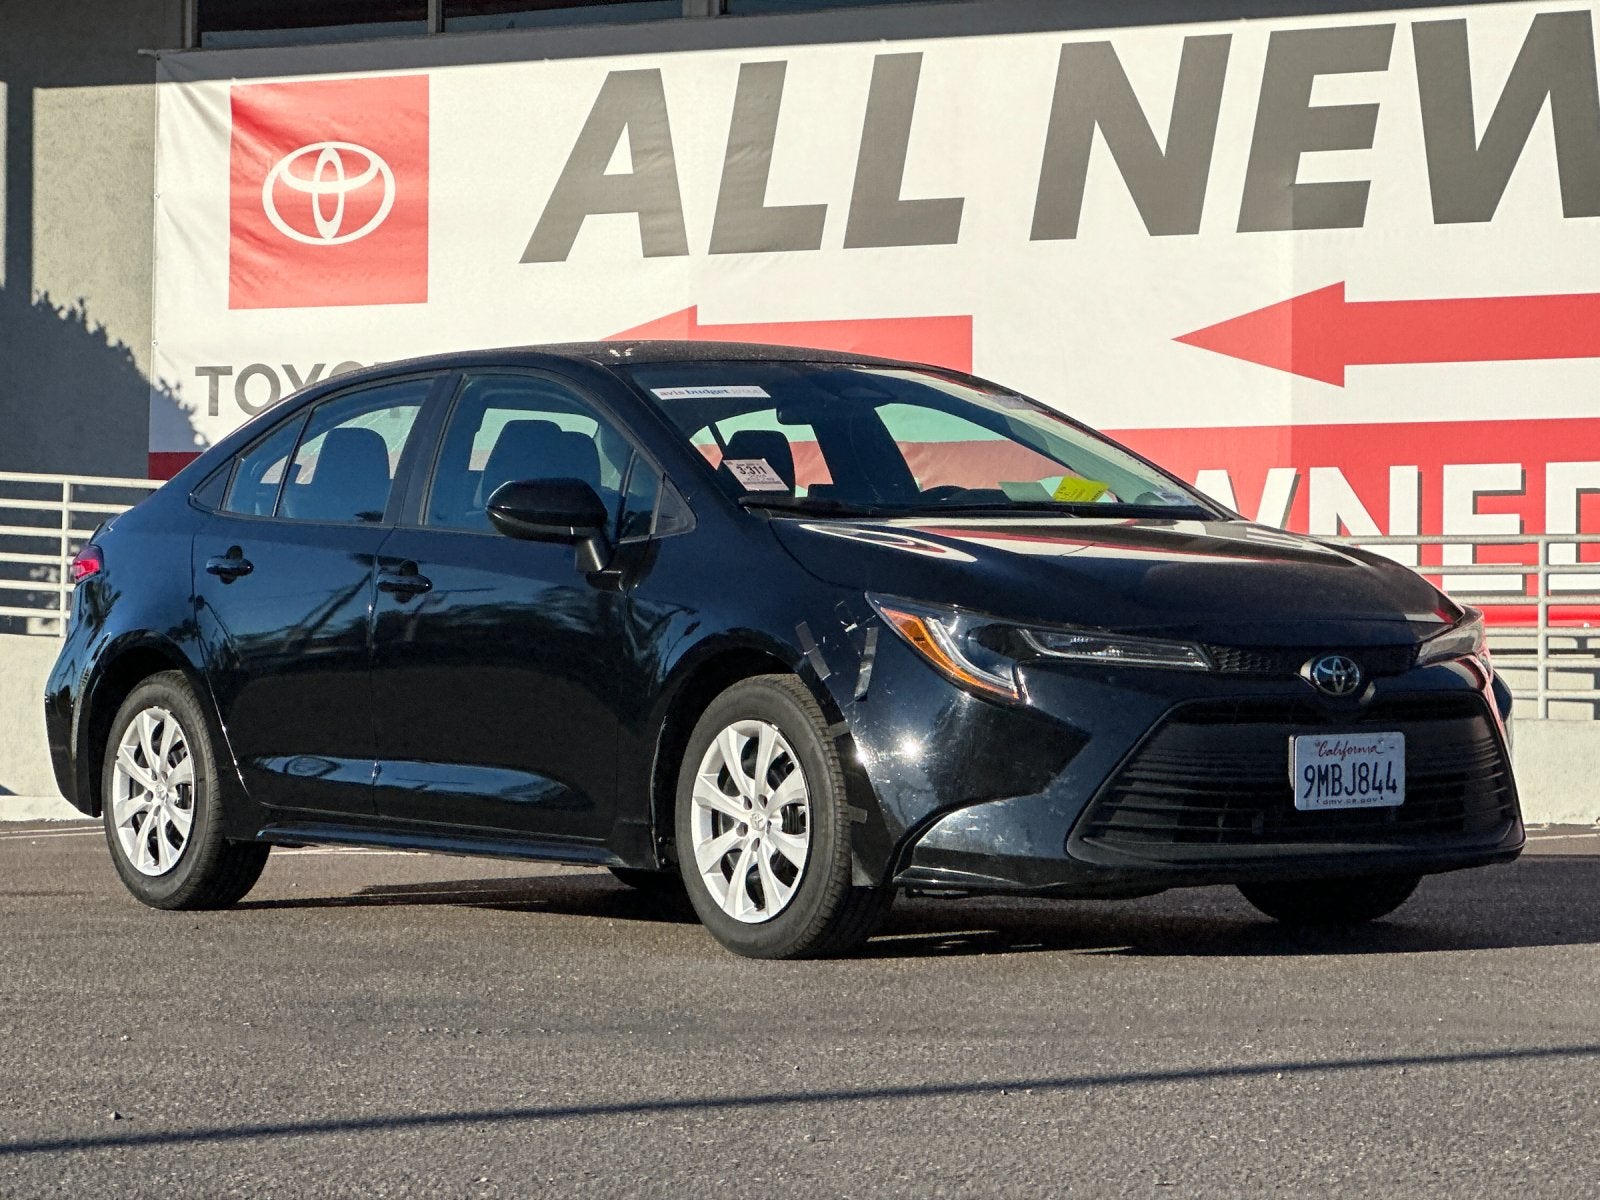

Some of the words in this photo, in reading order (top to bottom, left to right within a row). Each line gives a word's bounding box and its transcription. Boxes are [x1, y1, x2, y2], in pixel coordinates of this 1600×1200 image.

[519, 51, 965, 264] ALL
[1028, 9, 1600, 241] NEW
[194, 360, 390, 417] TOY
[685, 388, 729, 396] budget
[1318, 740, 1384, 761] California
[1303, 760, 1398, 799] 9MBJ844
[1322, 797, 1378, 806] dmv.ca.gov
